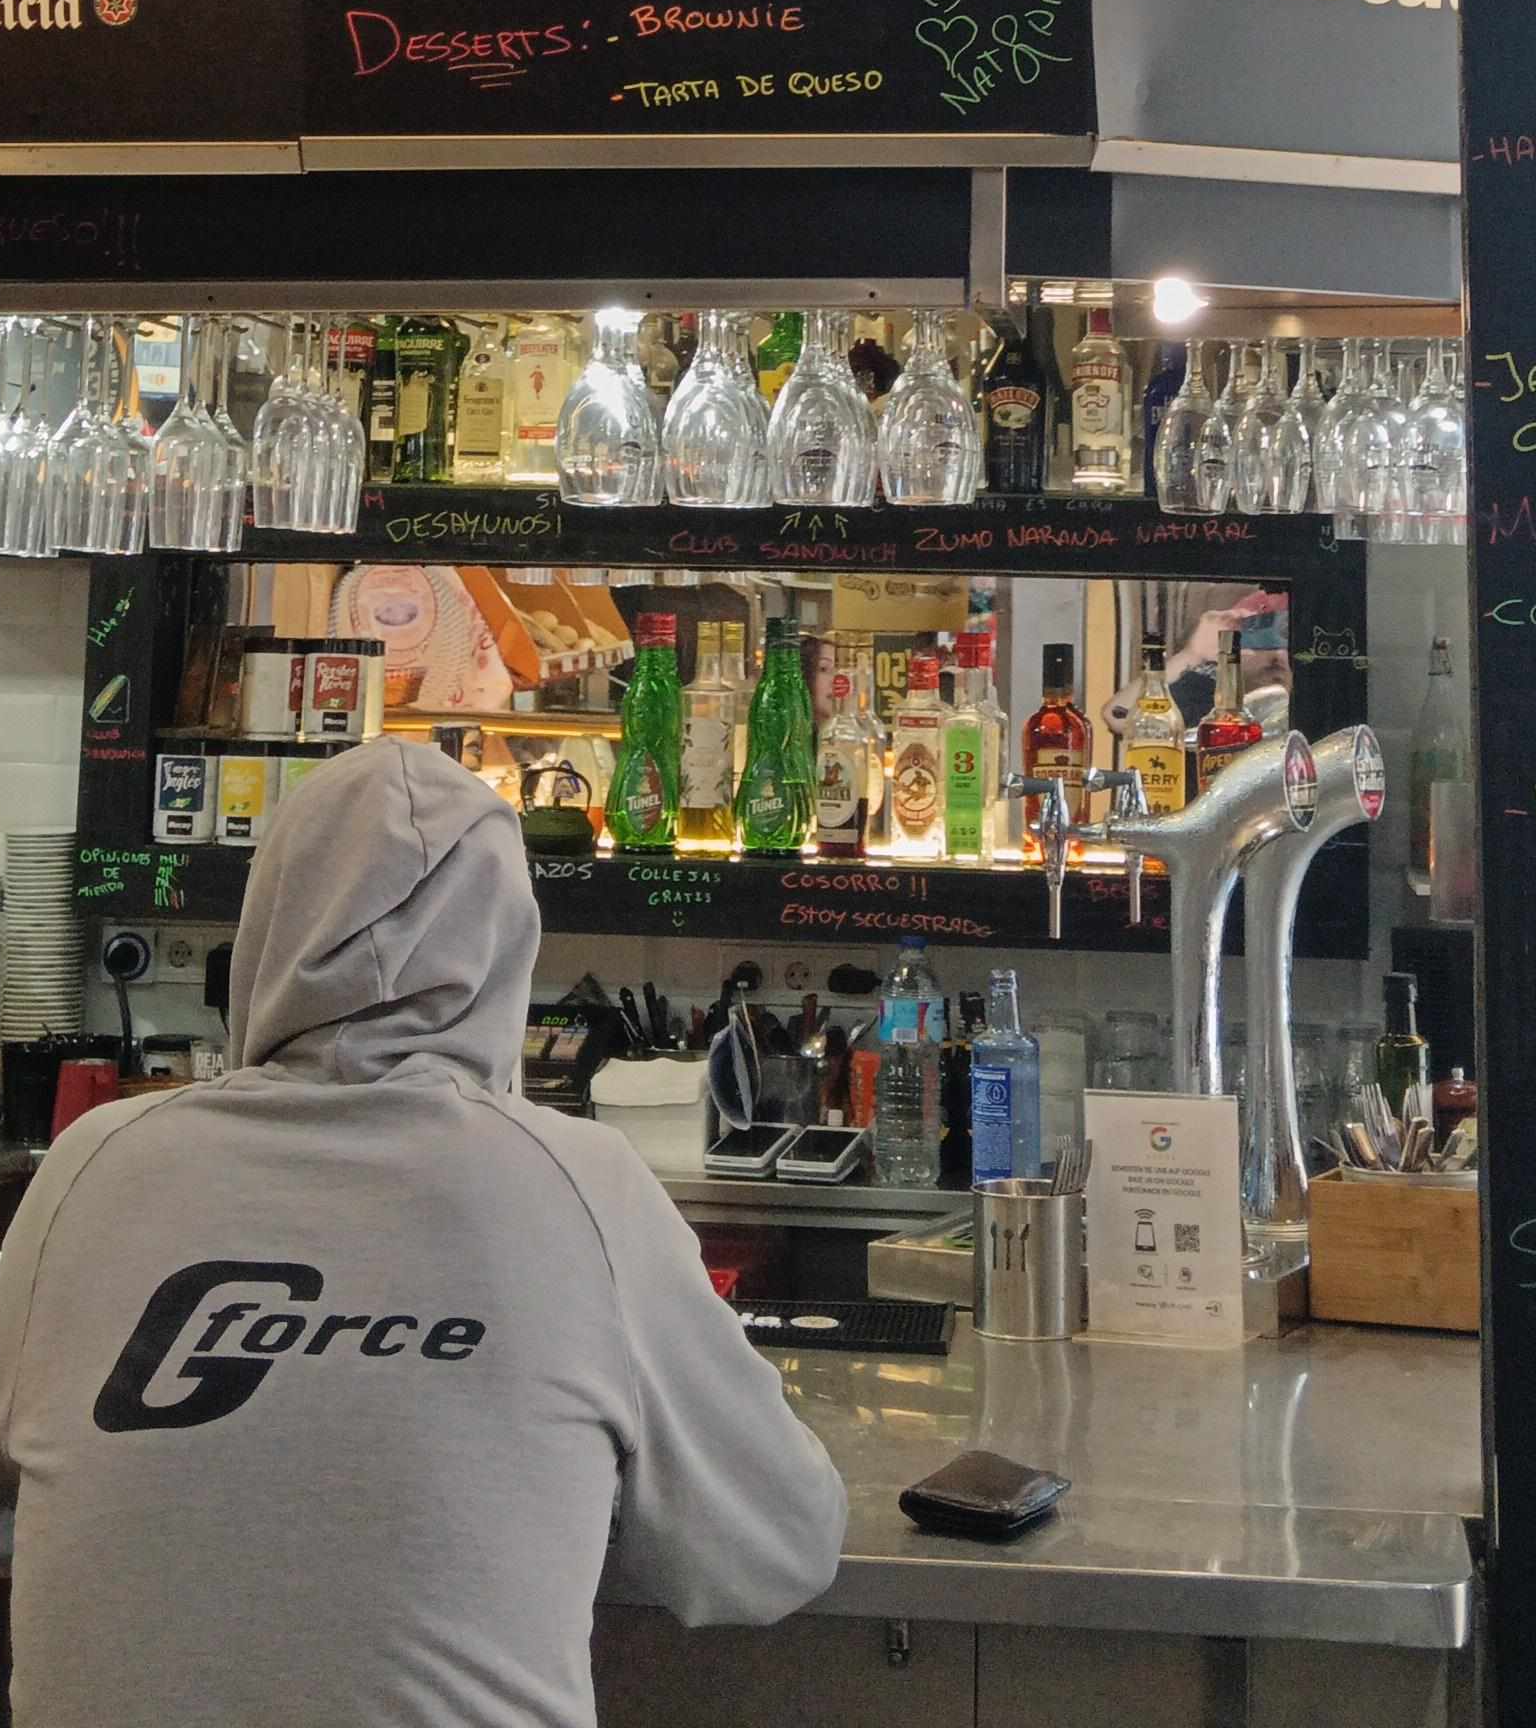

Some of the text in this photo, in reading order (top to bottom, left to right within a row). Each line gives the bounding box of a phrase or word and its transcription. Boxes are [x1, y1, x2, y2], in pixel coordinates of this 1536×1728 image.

[735, 75, 776, 100] DE
[787, 69, 884, 102] QUESO
[669, 531, 899, 564] CLUB SANDWICH
[913, 521, 1257, 554] ZUMO NARANJA NATURAL
[953, 750, 976, 775] 3
[1140, 772, 1181, 787] ERRY
[626, 793, 662, 812] TUNEL
[749, 796, 785, 815] TUNEL
[102, 866, 122, 881] DE
[628, 865, 723, 886] COLLEJAS
